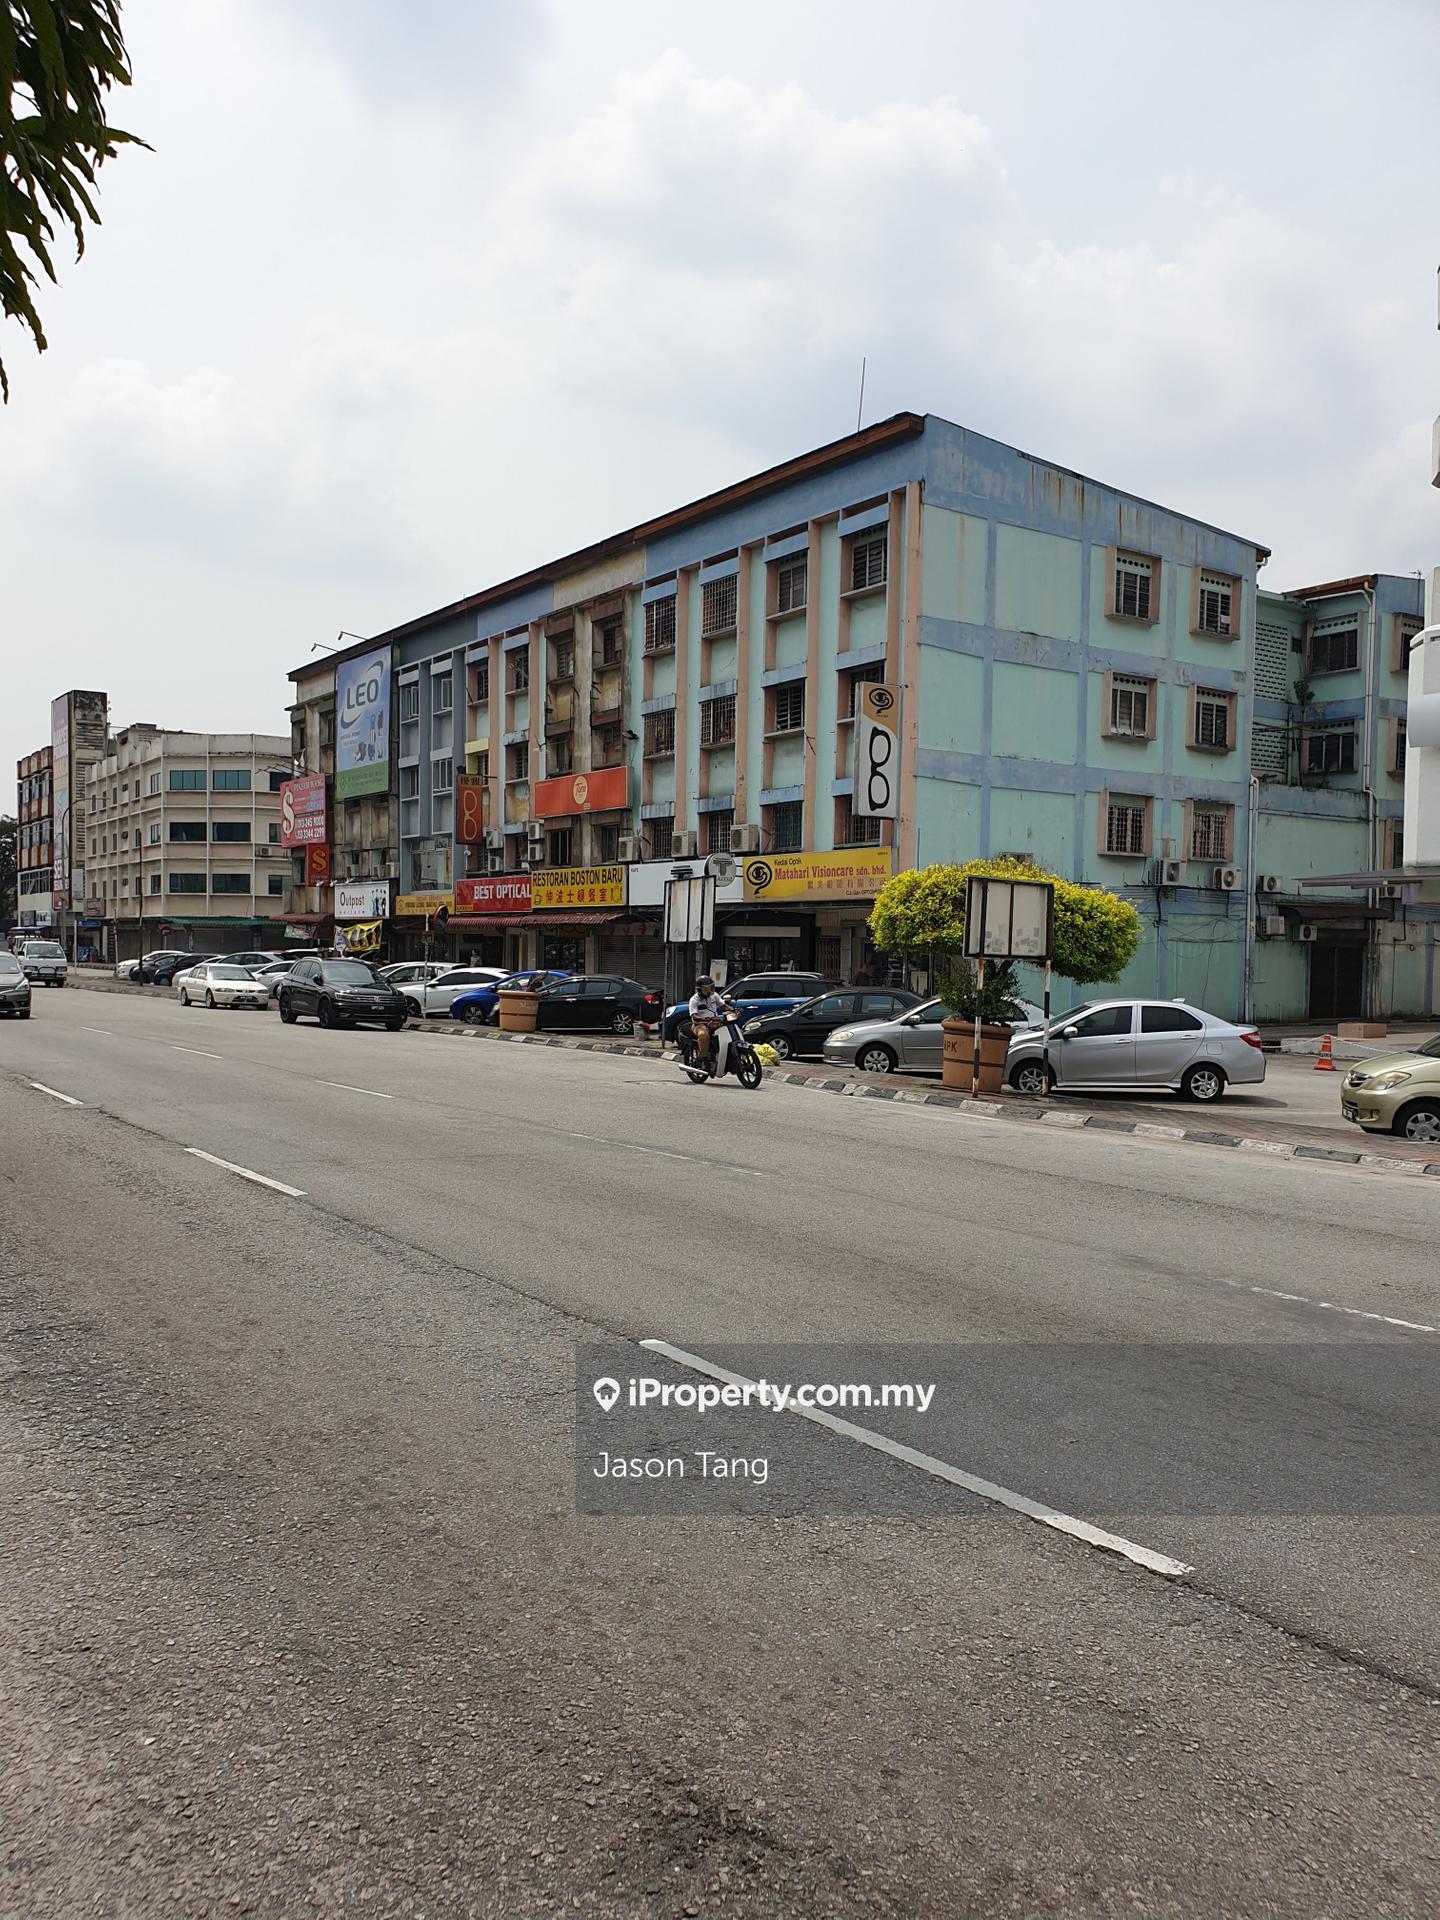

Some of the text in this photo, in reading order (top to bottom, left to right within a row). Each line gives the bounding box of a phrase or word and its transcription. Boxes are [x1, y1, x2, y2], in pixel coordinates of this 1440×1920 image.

[346, 679, 379, 710] LEO
[533, 867, 623, 887] RESTORAN BOSTON BARU
[774, 866, 809, 881] Matahari
[812, 864, 854, 879] Visioncare
[340, 891, 365, 909] Outpost
[474, 883, 532, 900] BEST OPTICAL
